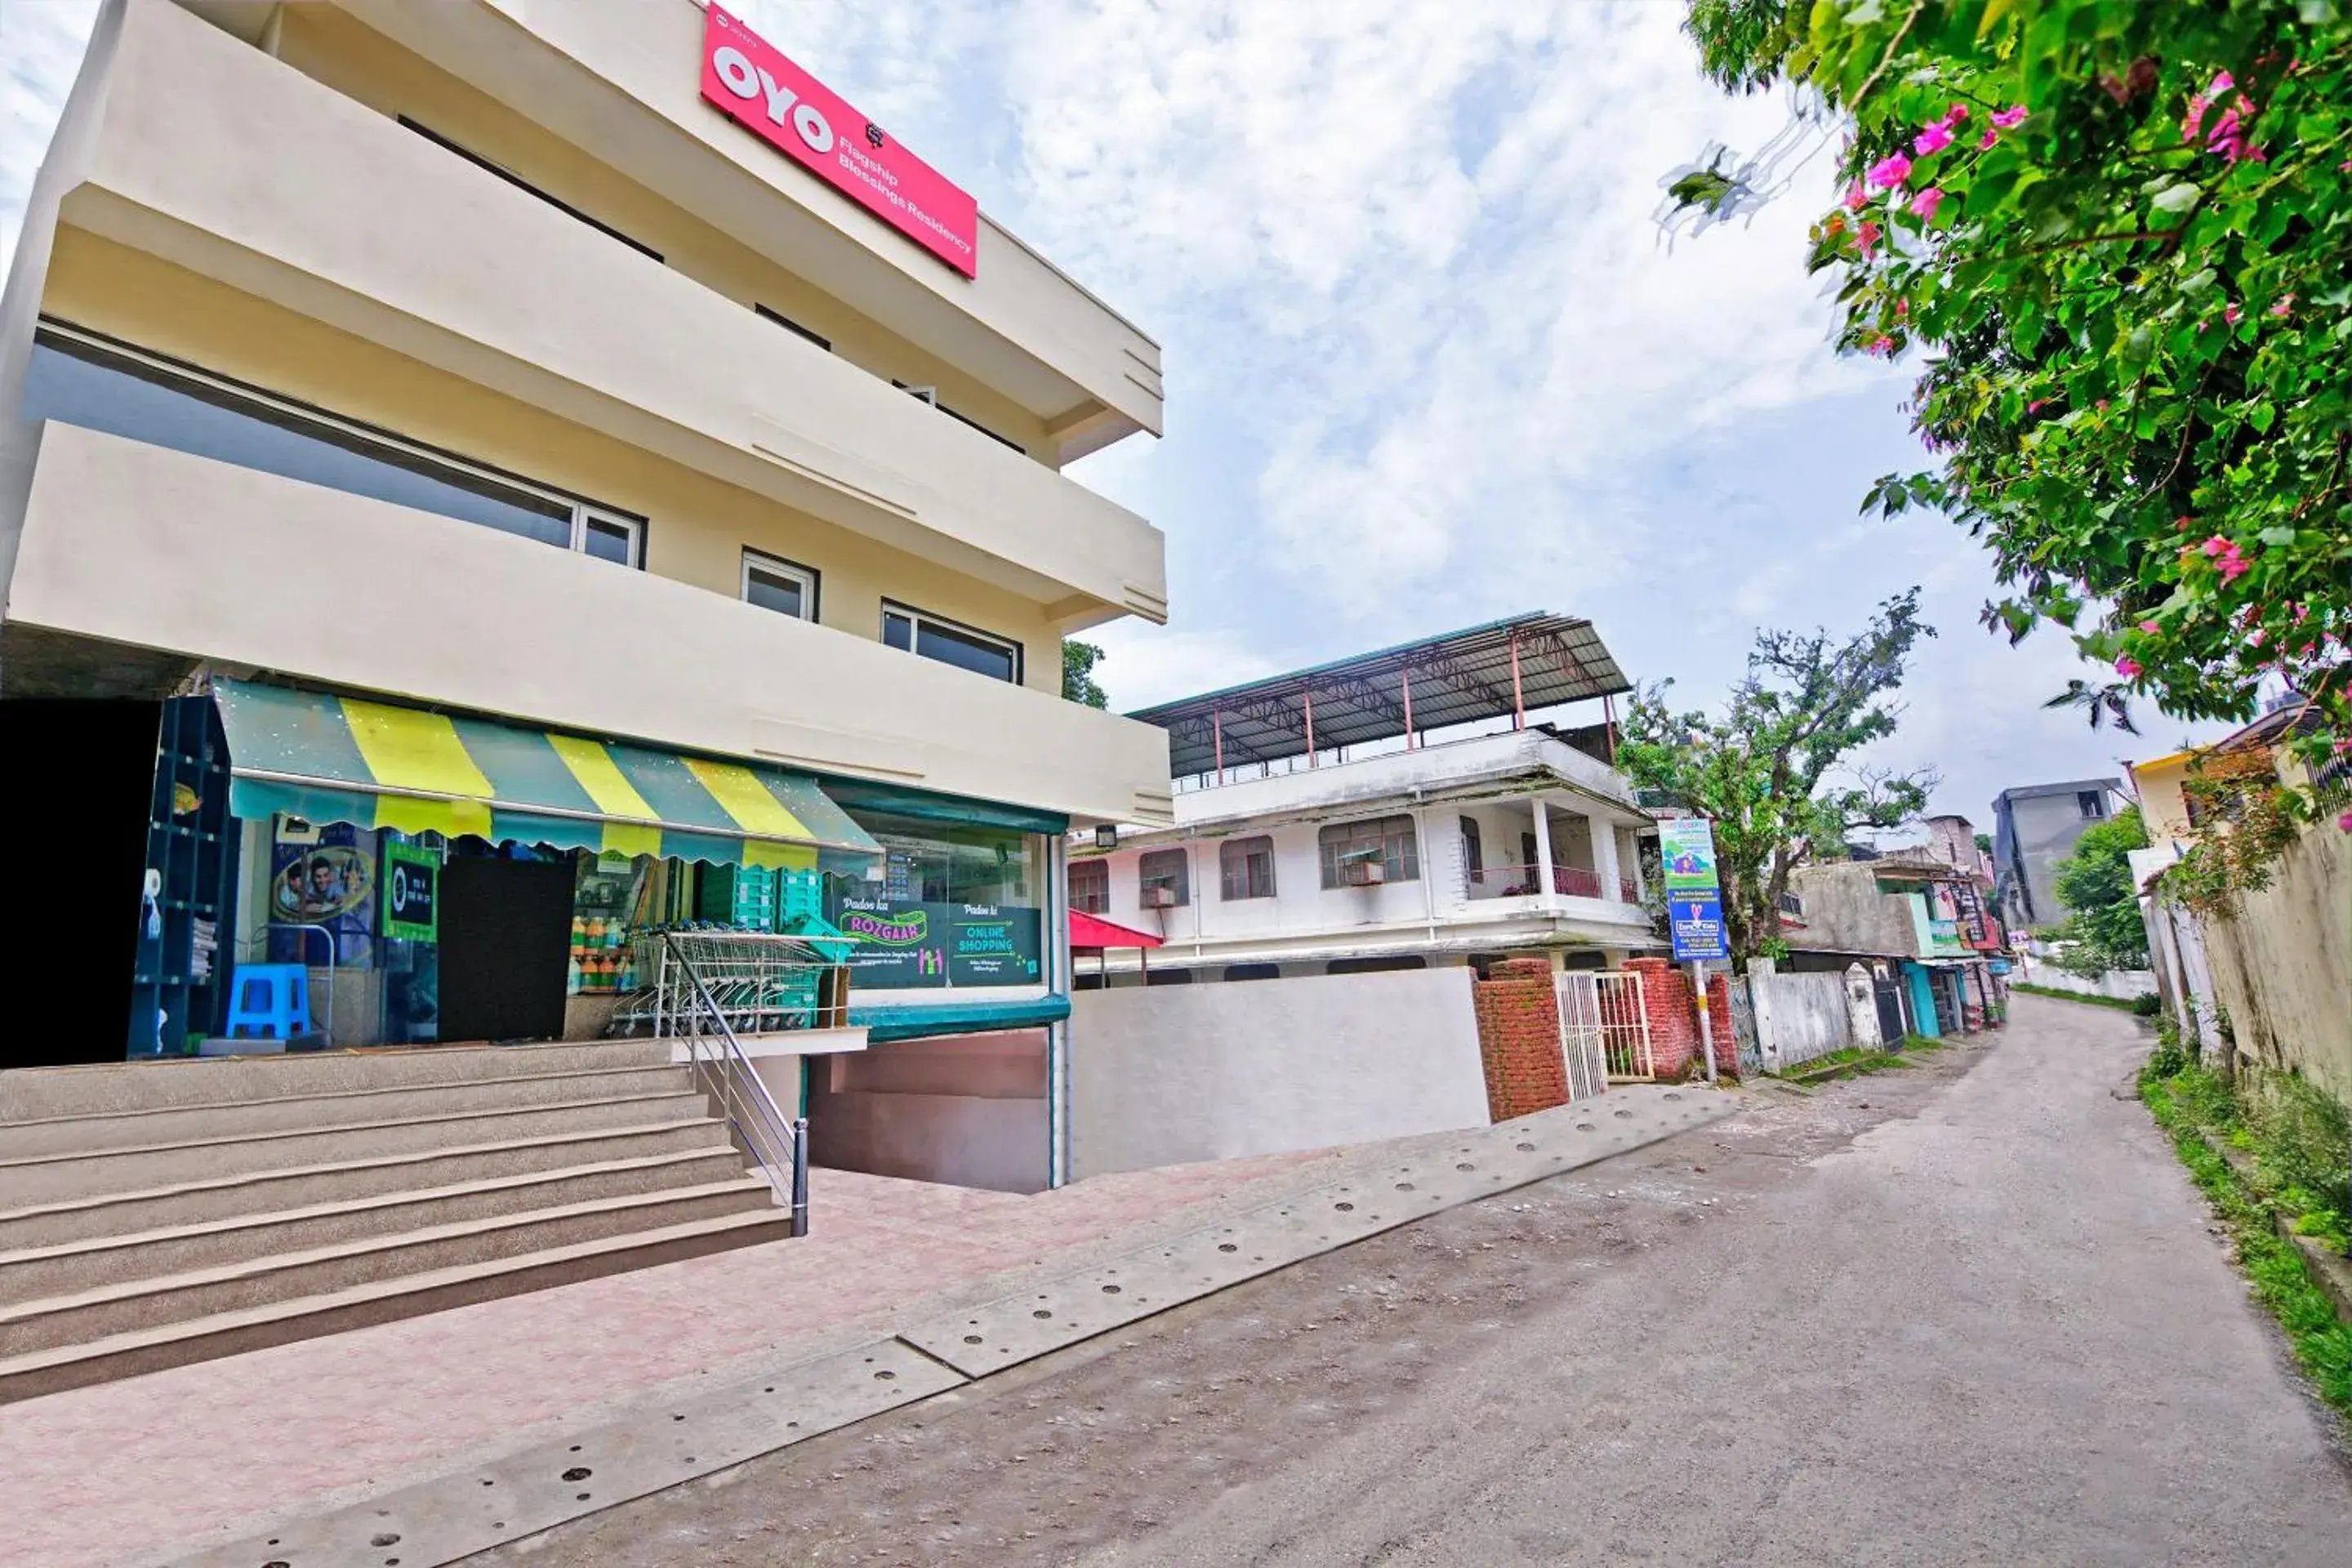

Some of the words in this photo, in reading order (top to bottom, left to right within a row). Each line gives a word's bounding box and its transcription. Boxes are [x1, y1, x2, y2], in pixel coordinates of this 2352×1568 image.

[713, 46, 834, 154] OYO
[839, 135, 898, 187] Flagship
[839, 153, 906, 209] Blessings
[906, 200, 972, 254] Residency
[843, 898, 875, 910] Pados
[876, 898, 889, 911] ka
[851, 915, 918, 940] ROZGAAR
[966, 926, 1004, 938] ONLINE
[959, 939, 1013, 951] SHOPPING
